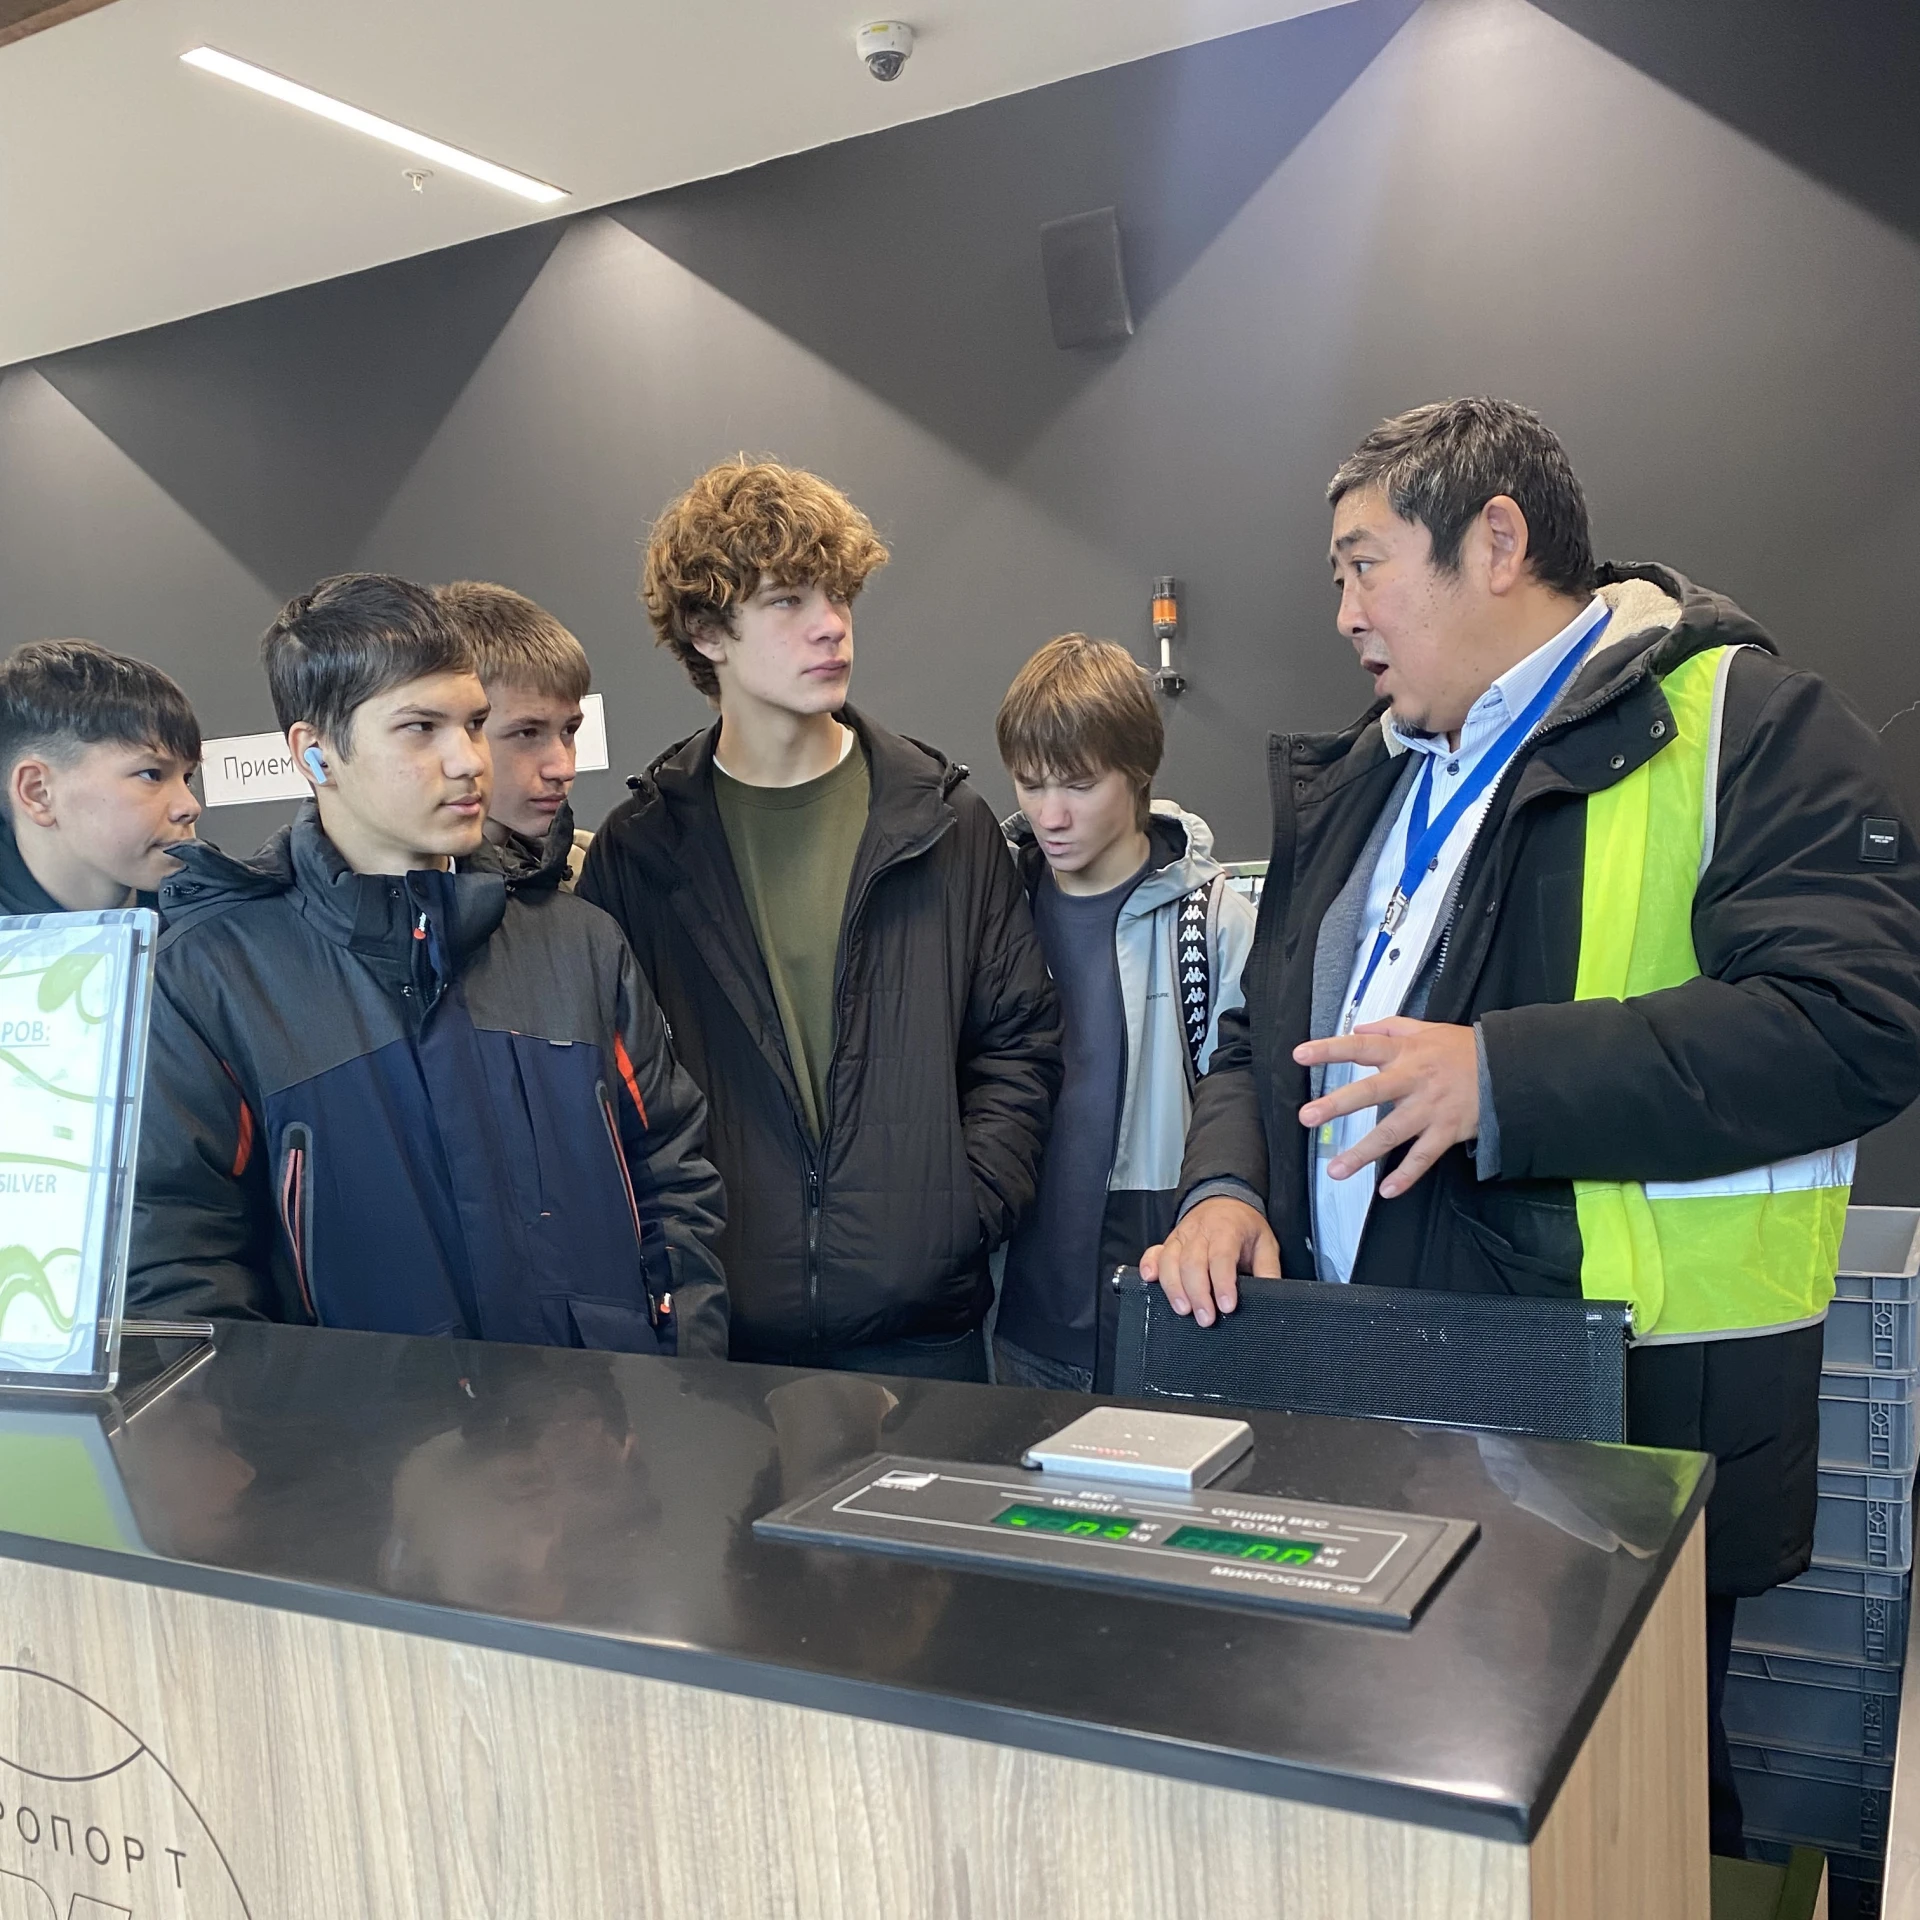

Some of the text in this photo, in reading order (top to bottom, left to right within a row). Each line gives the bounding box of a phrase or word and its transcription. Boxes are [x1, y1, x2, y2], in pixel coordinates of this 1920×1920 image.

[223, 756, 295, 785] Прием
[1052, 1497, 1123, 1513] WEIGHT
[1230, 1519, 1290, 1535] TOTAL
[1287, 1516, 1330, 1529] ВЕС
[0, 1802, 187, 1889] ОПОРТ
